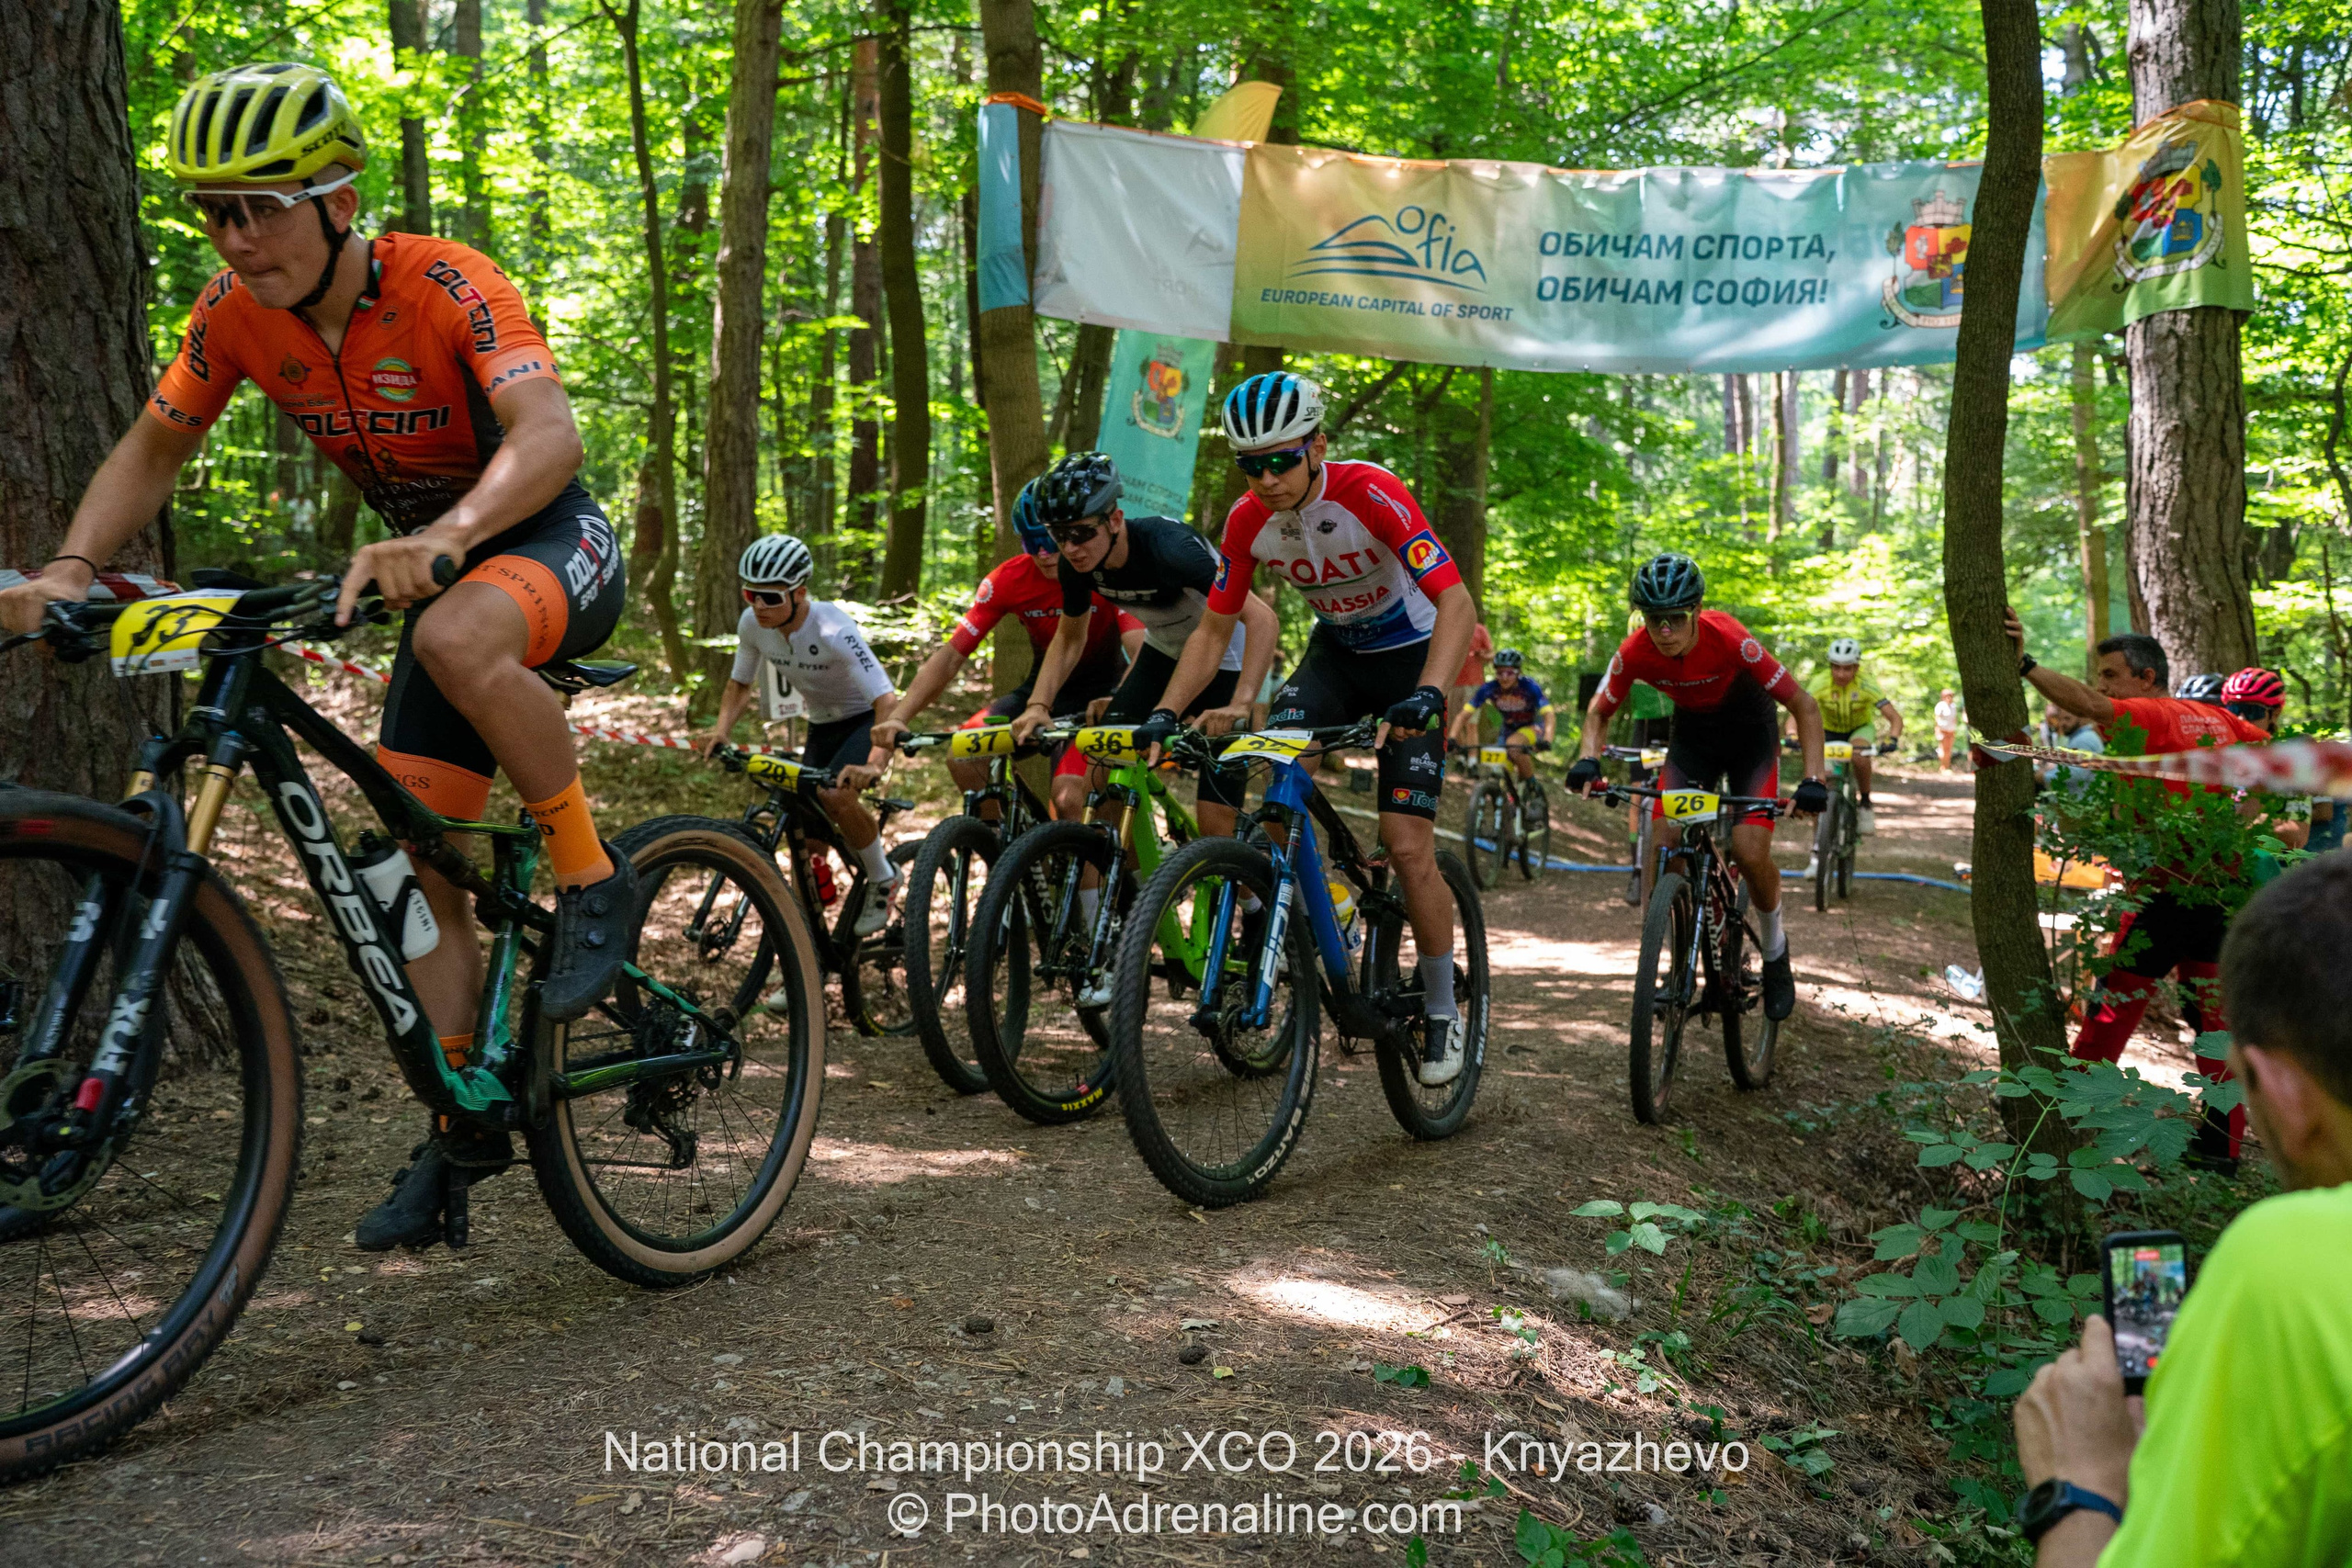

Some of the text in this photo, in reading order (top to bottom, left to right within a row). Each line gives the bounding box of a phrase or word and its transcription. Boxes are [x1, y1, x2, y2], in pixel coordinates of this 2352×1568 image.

[1539, 231, 1837, 264] ОБИЧАМ СПОРТА,
[423, 259, 499, 354] DOLTCINI
[1261, 288, 1514, 321] EUROPEAN CAPITAL OF SPORT
[1536, 276, 1829, 308] ОБИЧАМ СОФИЯ!
[843, 634, 874, 673] RYSEL
[966, 730, 999, 753] 37
[1091, 730, 1123, 755] 36
[396, 773, 430, 789] GS
[1673, 795, 1704, 815] 26
[278, 781, 418, 1037] ORBEA
[1061, 1087, 1104, 1111] MAXXIS
